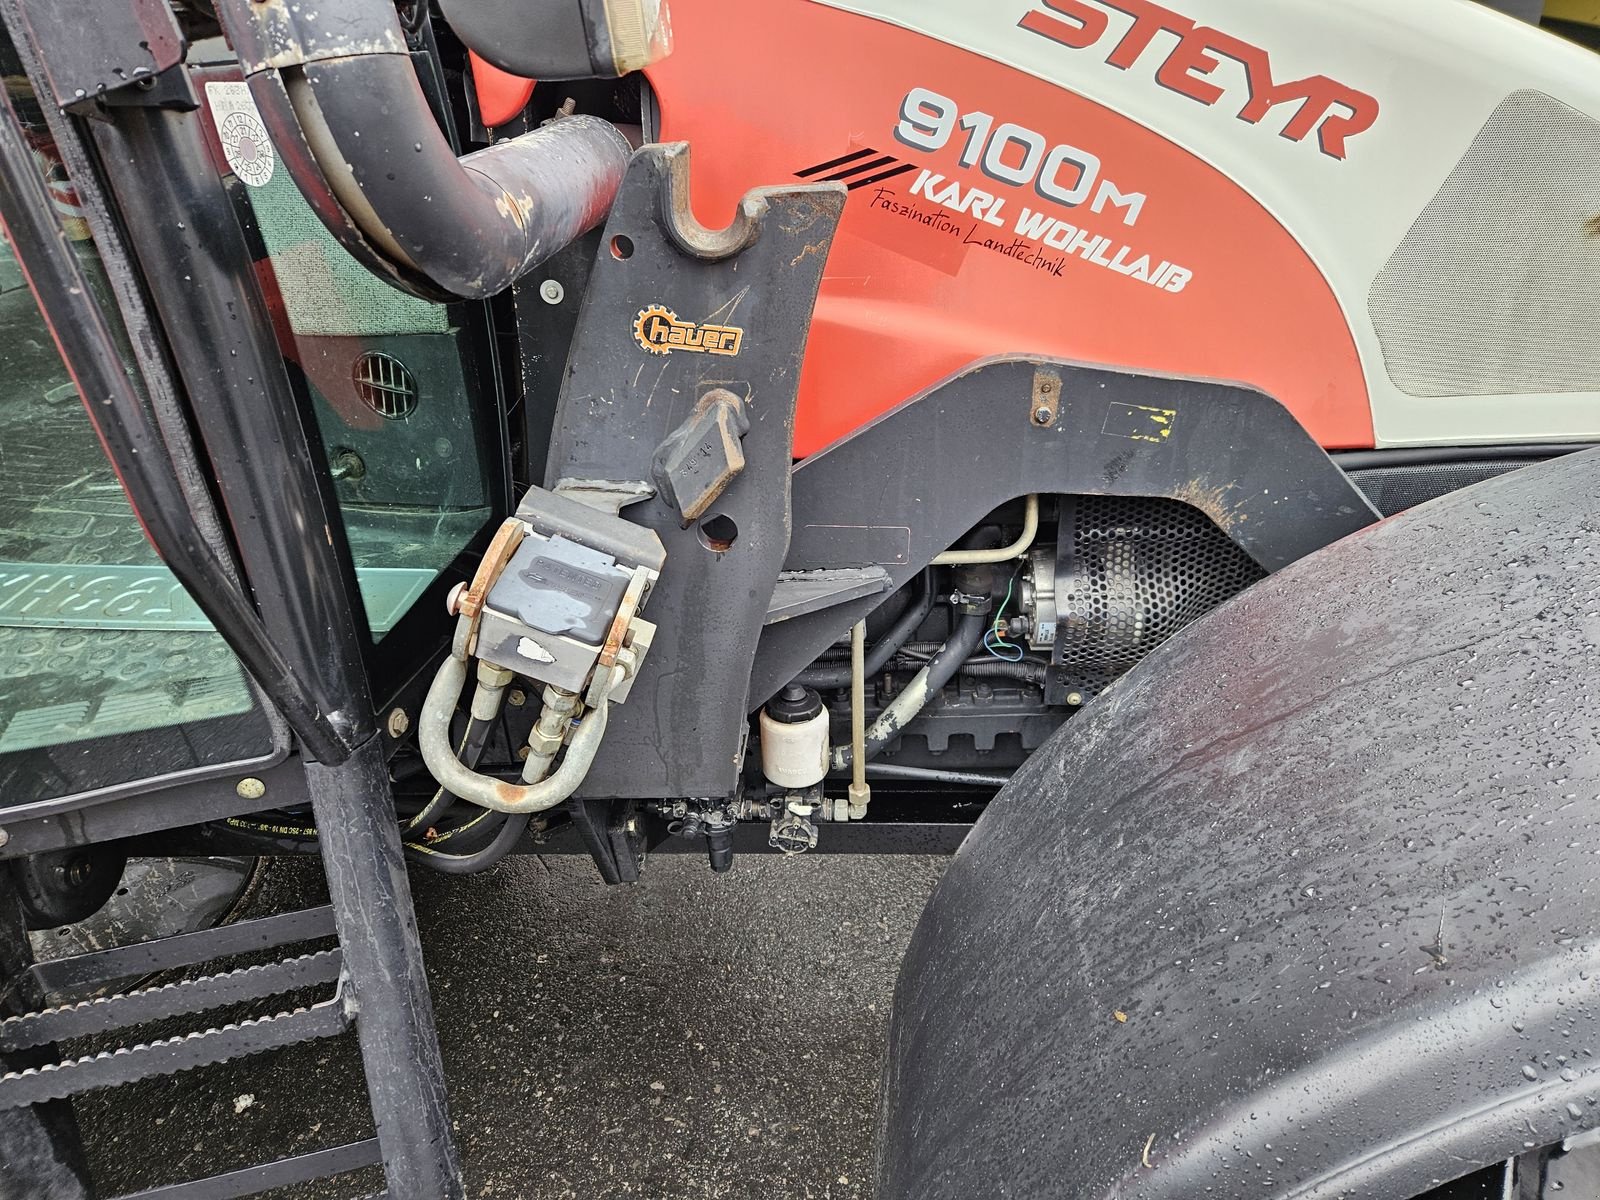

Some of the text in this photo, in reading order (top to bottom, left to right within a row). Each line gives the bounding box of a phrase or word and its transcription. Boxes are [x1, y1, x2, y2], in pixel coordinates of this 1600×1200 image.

[1016, 0, 1380, 162] STEYR
[870, 186, 1067, 278] Faszination Landtechnik
[909, 168, 1193, 293] KARL WOHLLAIB
[648, 316, 736, 350] hauer
